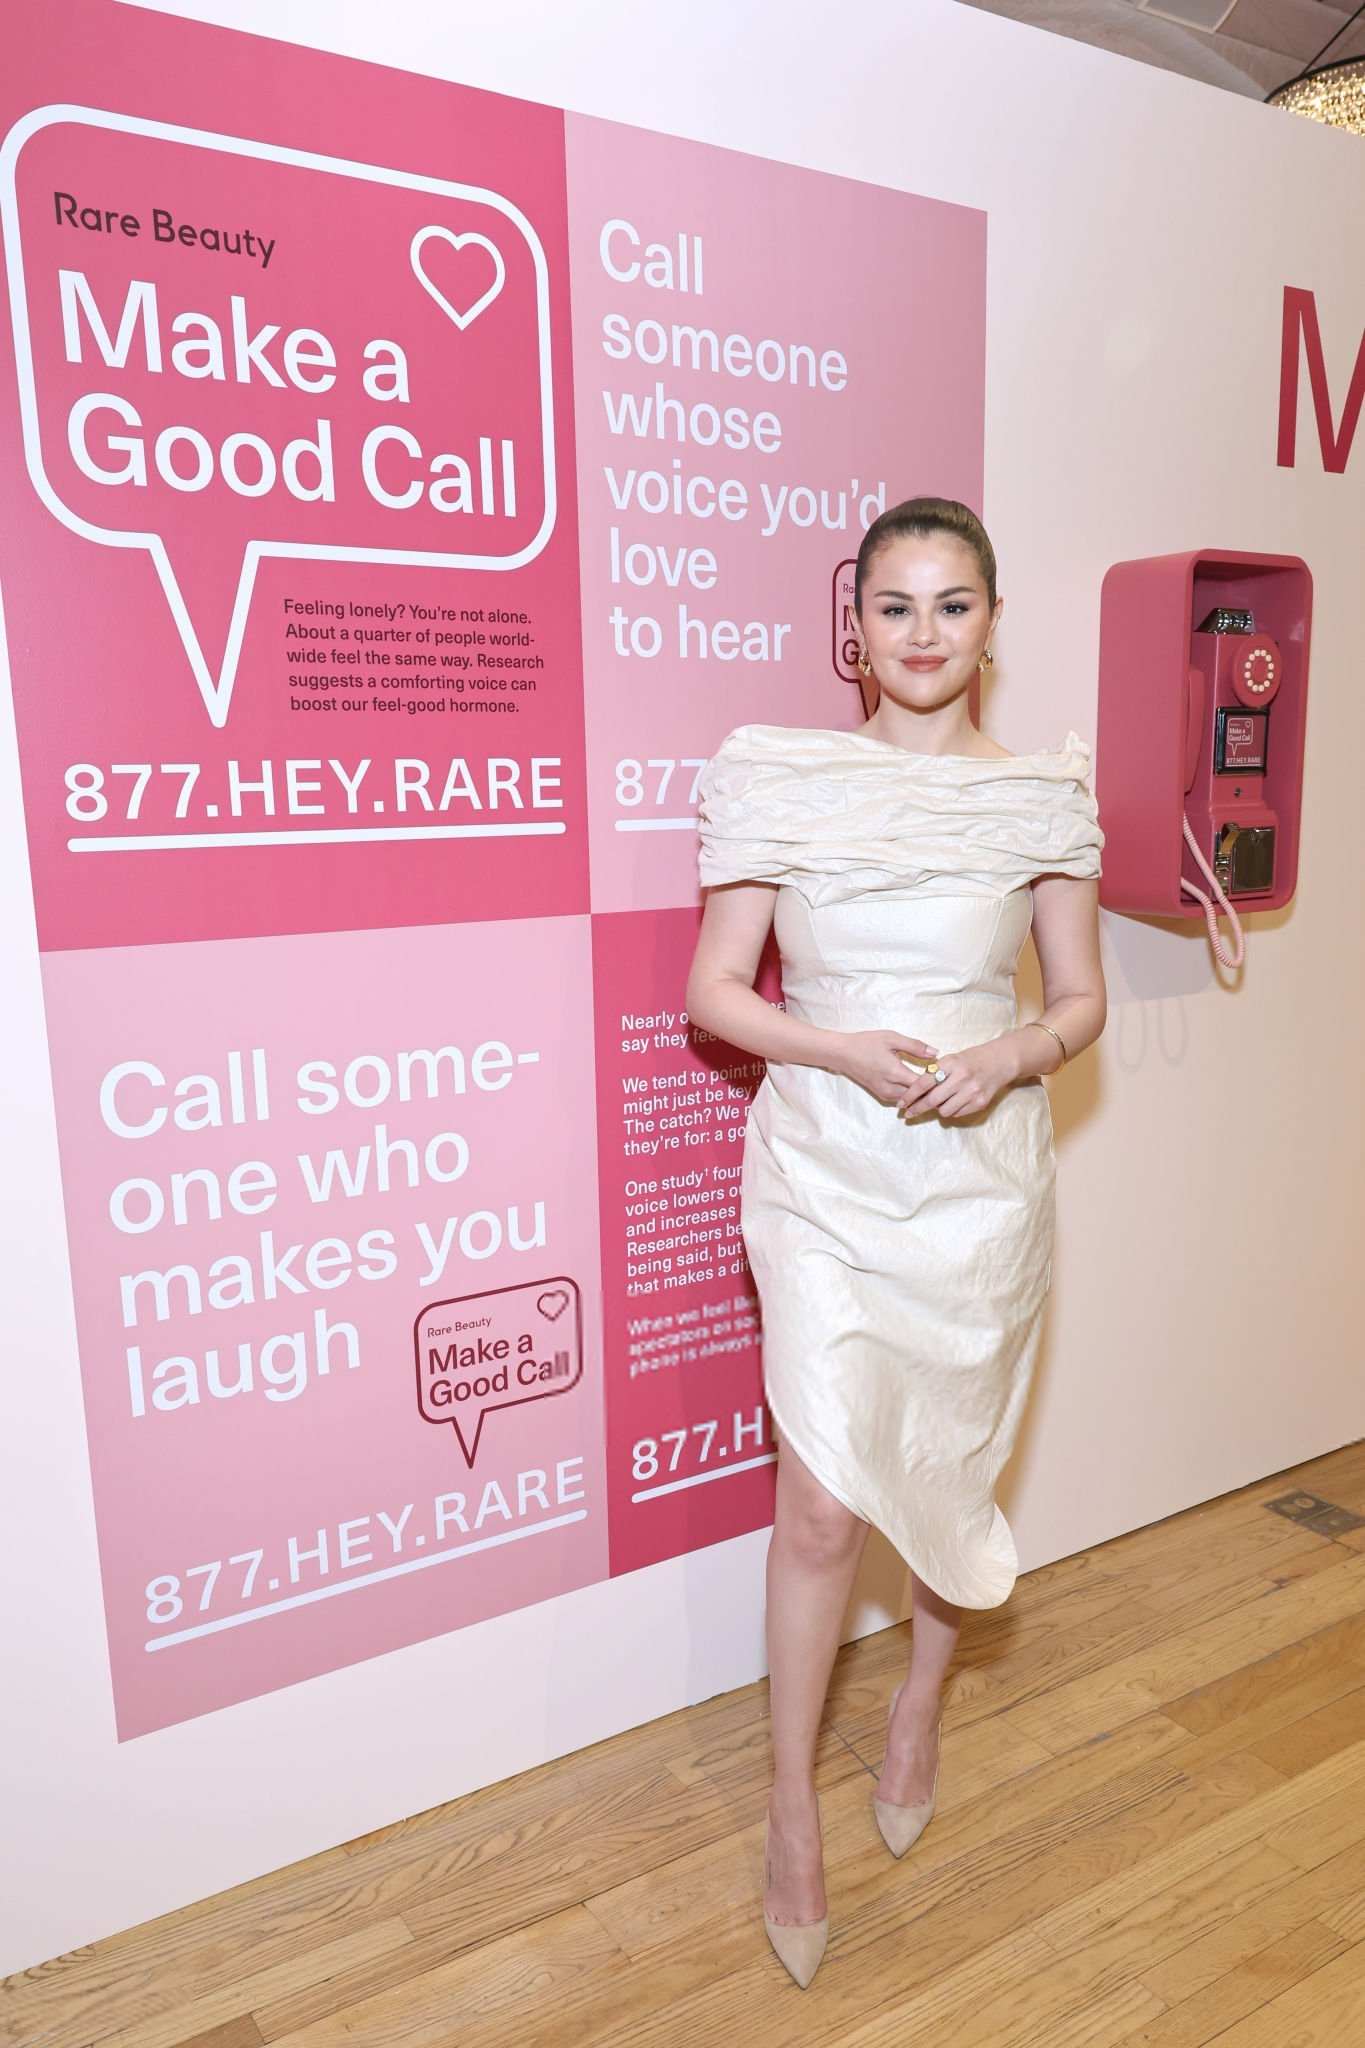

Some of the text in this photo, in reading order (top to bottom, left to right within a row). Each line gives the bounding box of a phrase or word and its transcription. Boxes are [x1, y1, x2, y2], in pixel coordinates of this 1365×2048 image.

[54, 191, 276, 269] Rare Beauty
[600, 218, 703, 296] Call
[58, 269, 410, 403] Make a
[602, 313, 848, 392] someone
[602, 382, 782, 453] whose
[67, 392, 516, 517] Good Call
[604, 459, 748, 521] voice
[610, 527, 718, 589] love
[284, 599, 532, 624] Feeling lonely? You're not alone.
[285, 624, 535, 646] About a quarter of people world-
[610, 604, 791, 661] to hear
[287, 649, 544, 670] wide feel the same way. Research
[289, 674, 536, 692] suggests a comforting voice can
[290, 696, 519, 714] boost our feel-good hormone.
[63, 757, 563, 820] 877.HEY.RARE
[621, 1011, 675, 1031] Nearly
[621, 1037, 649, 1054] say
[654, 1032, 688, 1048] they
[99, 1040, 540, 1139] Call some-
[622, 1077, 648, 1094] We
[652, 1071, 687, 1089] tend
[691, 1072, 705, 1085] to
[711, 1064, 748, 1085] point
[623, 1096, 669, 1116] might
[672, 1091, 701, 1112] just
[705, 1088, 724, 1103] be
[728, 1085, 753, 1101] key
[624, 1119, 655, 1136] The
[659, 1108, 712, 1130] catch?
[716, 1105, 740, 1121] We
[623, 1135, 680, 1156] they're
[684, 1131, 710, 1147] for:
[714, 1130, 723, 1142] a
[109, 1124, 470, 1234] one who
[625, 1180, 657, 1197] One
[625, 1199, 668, 1217] voice
[673, 1187, 725, 1208] lowers
[626, 1206, 736, 1238] and increases
[627, 1227, 722, 1257] Researchers
[627, 1241, 742, 1277] being said, but
[119, 1201, 546, 1327] makes you
[627, 1279, 659, 1294] that
[664, 1267, 714, 1289] makes
[718, 1265, 727, 1277] a
[427, 1317, 492, 1338] Rare Beauty
[127, 1309, 360, 1418] laugh
[428, 1334, 533, 1375] Make a
[430, 1351, 569, 1407] Good Call
[632, 1406, 763, 1481] 877.H
[145, 1456, 585, 1625] 877.HEY.RARE
